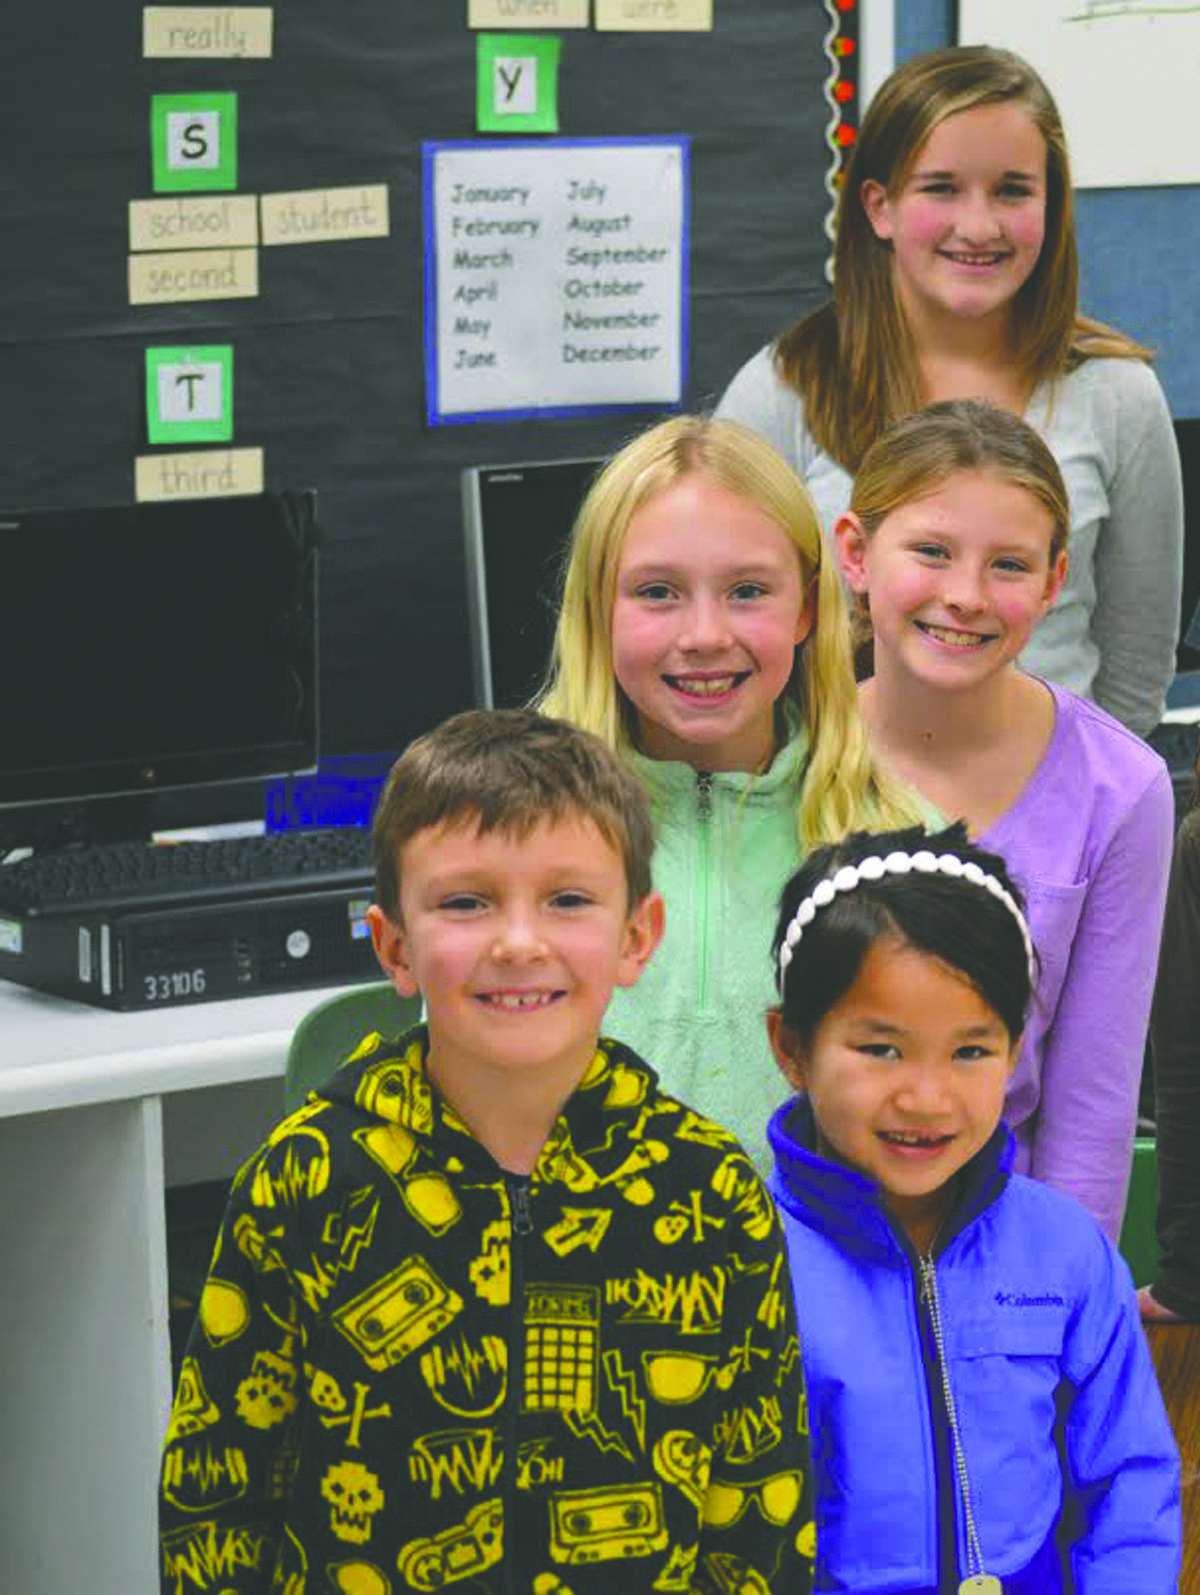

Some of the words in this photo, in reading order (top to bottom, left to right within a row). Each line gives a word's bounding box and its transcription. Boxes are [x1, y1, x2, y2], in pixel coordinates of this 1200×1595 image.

[168, 18, 247, 56] really
[180, 123, 209, 160] S
[450, 183, 531, 206] January
[566, 179, 607, 204] July
[150, 199, 231, 239] school
[276, 190, 379, 234] student
[451, 216, 541, 239] February
[567, 213, 633, 239] August
[452, 250, 514, 270] March
[566, 244, 669, 270] September
[147, 250, 239, 292] second
[453, 279, 498, 307] April
[563, 277, 645, 300] October
[453, 317, 492, 340] May
[562, 311, 661, 332] November
[454, 349, 497, 370] June
[562, 343, 661, 364] December
[174, 373, 205, 412] T
[159, 457, 239, 494] third
[143, 967, 207, 1001] 33106
[1006, 1292, 1064, 1307] Columbia
